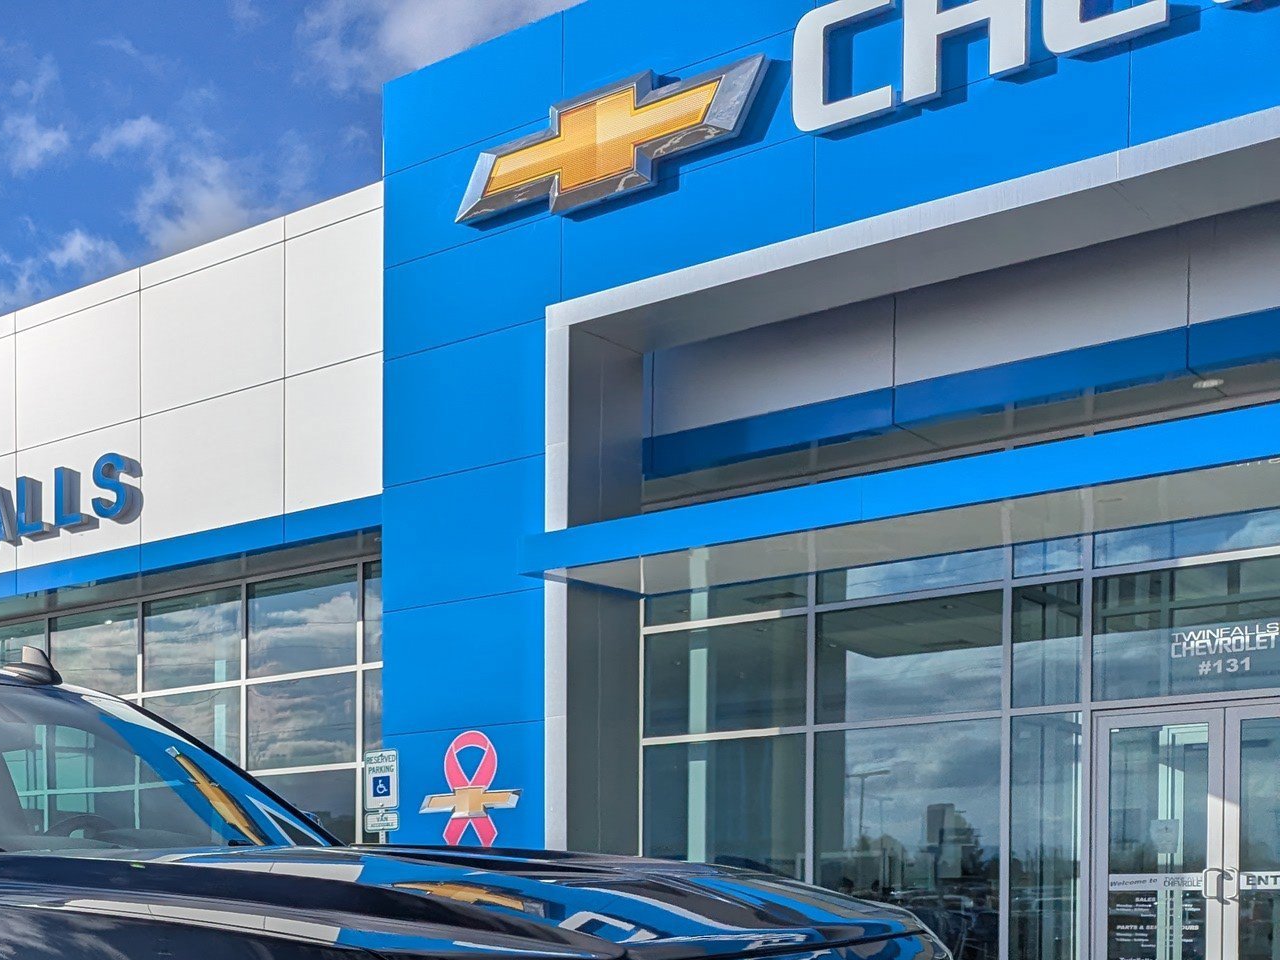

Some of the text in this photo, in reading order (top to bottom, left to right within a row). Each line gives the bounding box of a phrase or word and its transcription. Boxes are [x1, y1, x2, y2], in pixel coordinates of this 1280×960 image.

[1171, 622, 1280, 642] TWINFALLS
[1171, 632, 1280, 658] CHEVROLET
[1198, 656, 1251, 675] #131
[366, 754, 396, 764] RESERVED
[368, 765, 395, 775] PARKING
